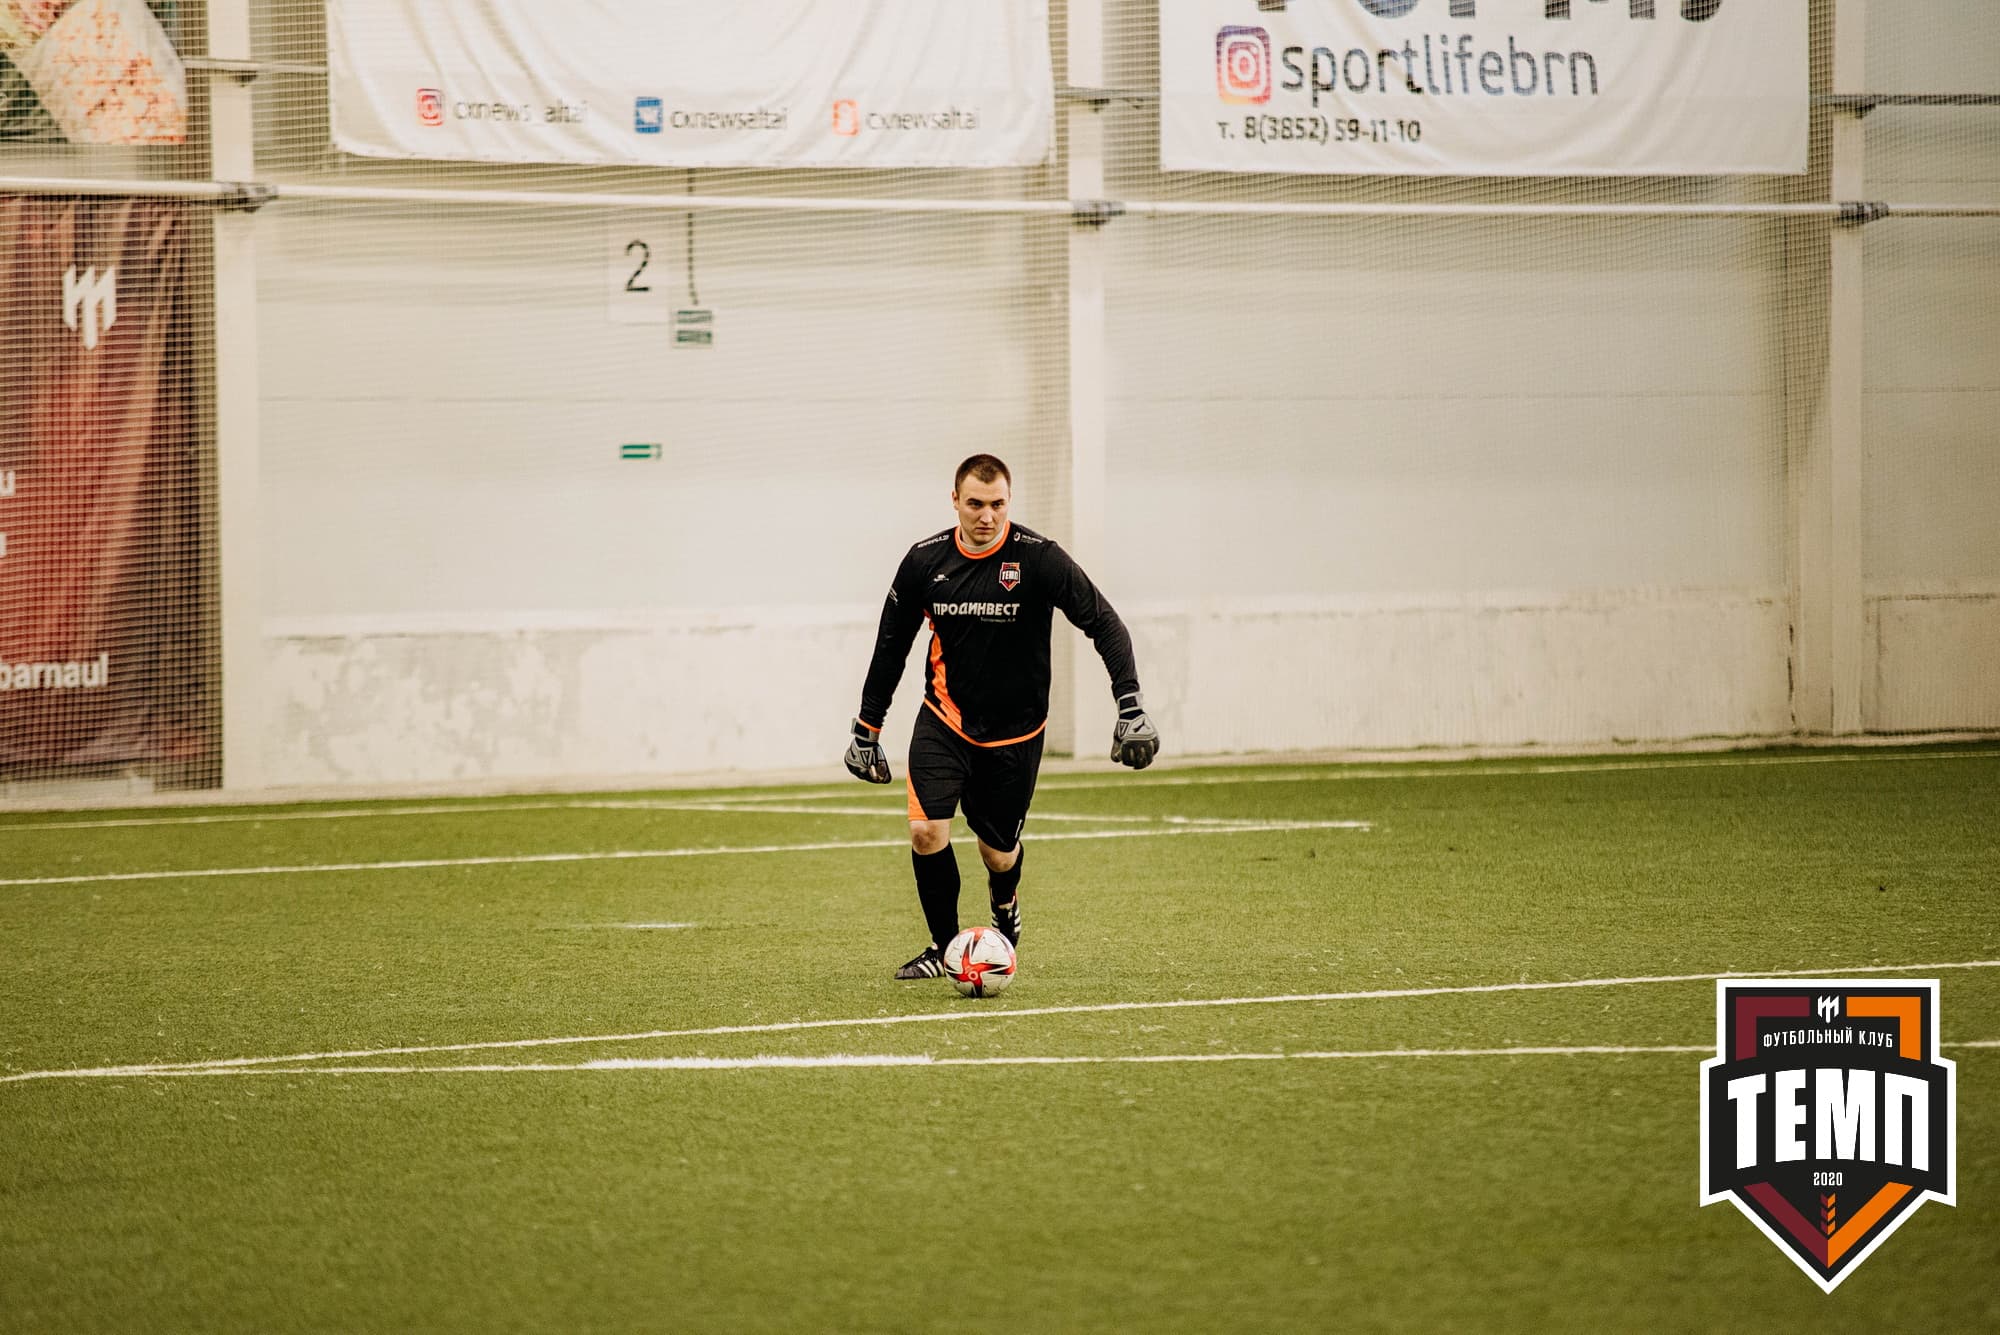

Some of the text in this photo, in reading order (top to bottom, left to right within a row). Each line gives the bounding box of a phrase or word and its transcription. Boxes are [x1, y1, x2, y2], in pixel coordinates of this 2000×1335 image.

[1282, 33, 1598, 108] sportlifebrn
[1244, 115, 1329, 145] 8(3852)
[1334, 118, 1422, 143] 59-11-10
[625, 240, 650, 292] 2
[933, 602, 1020, 617] ПРОДИНВЕСТ
